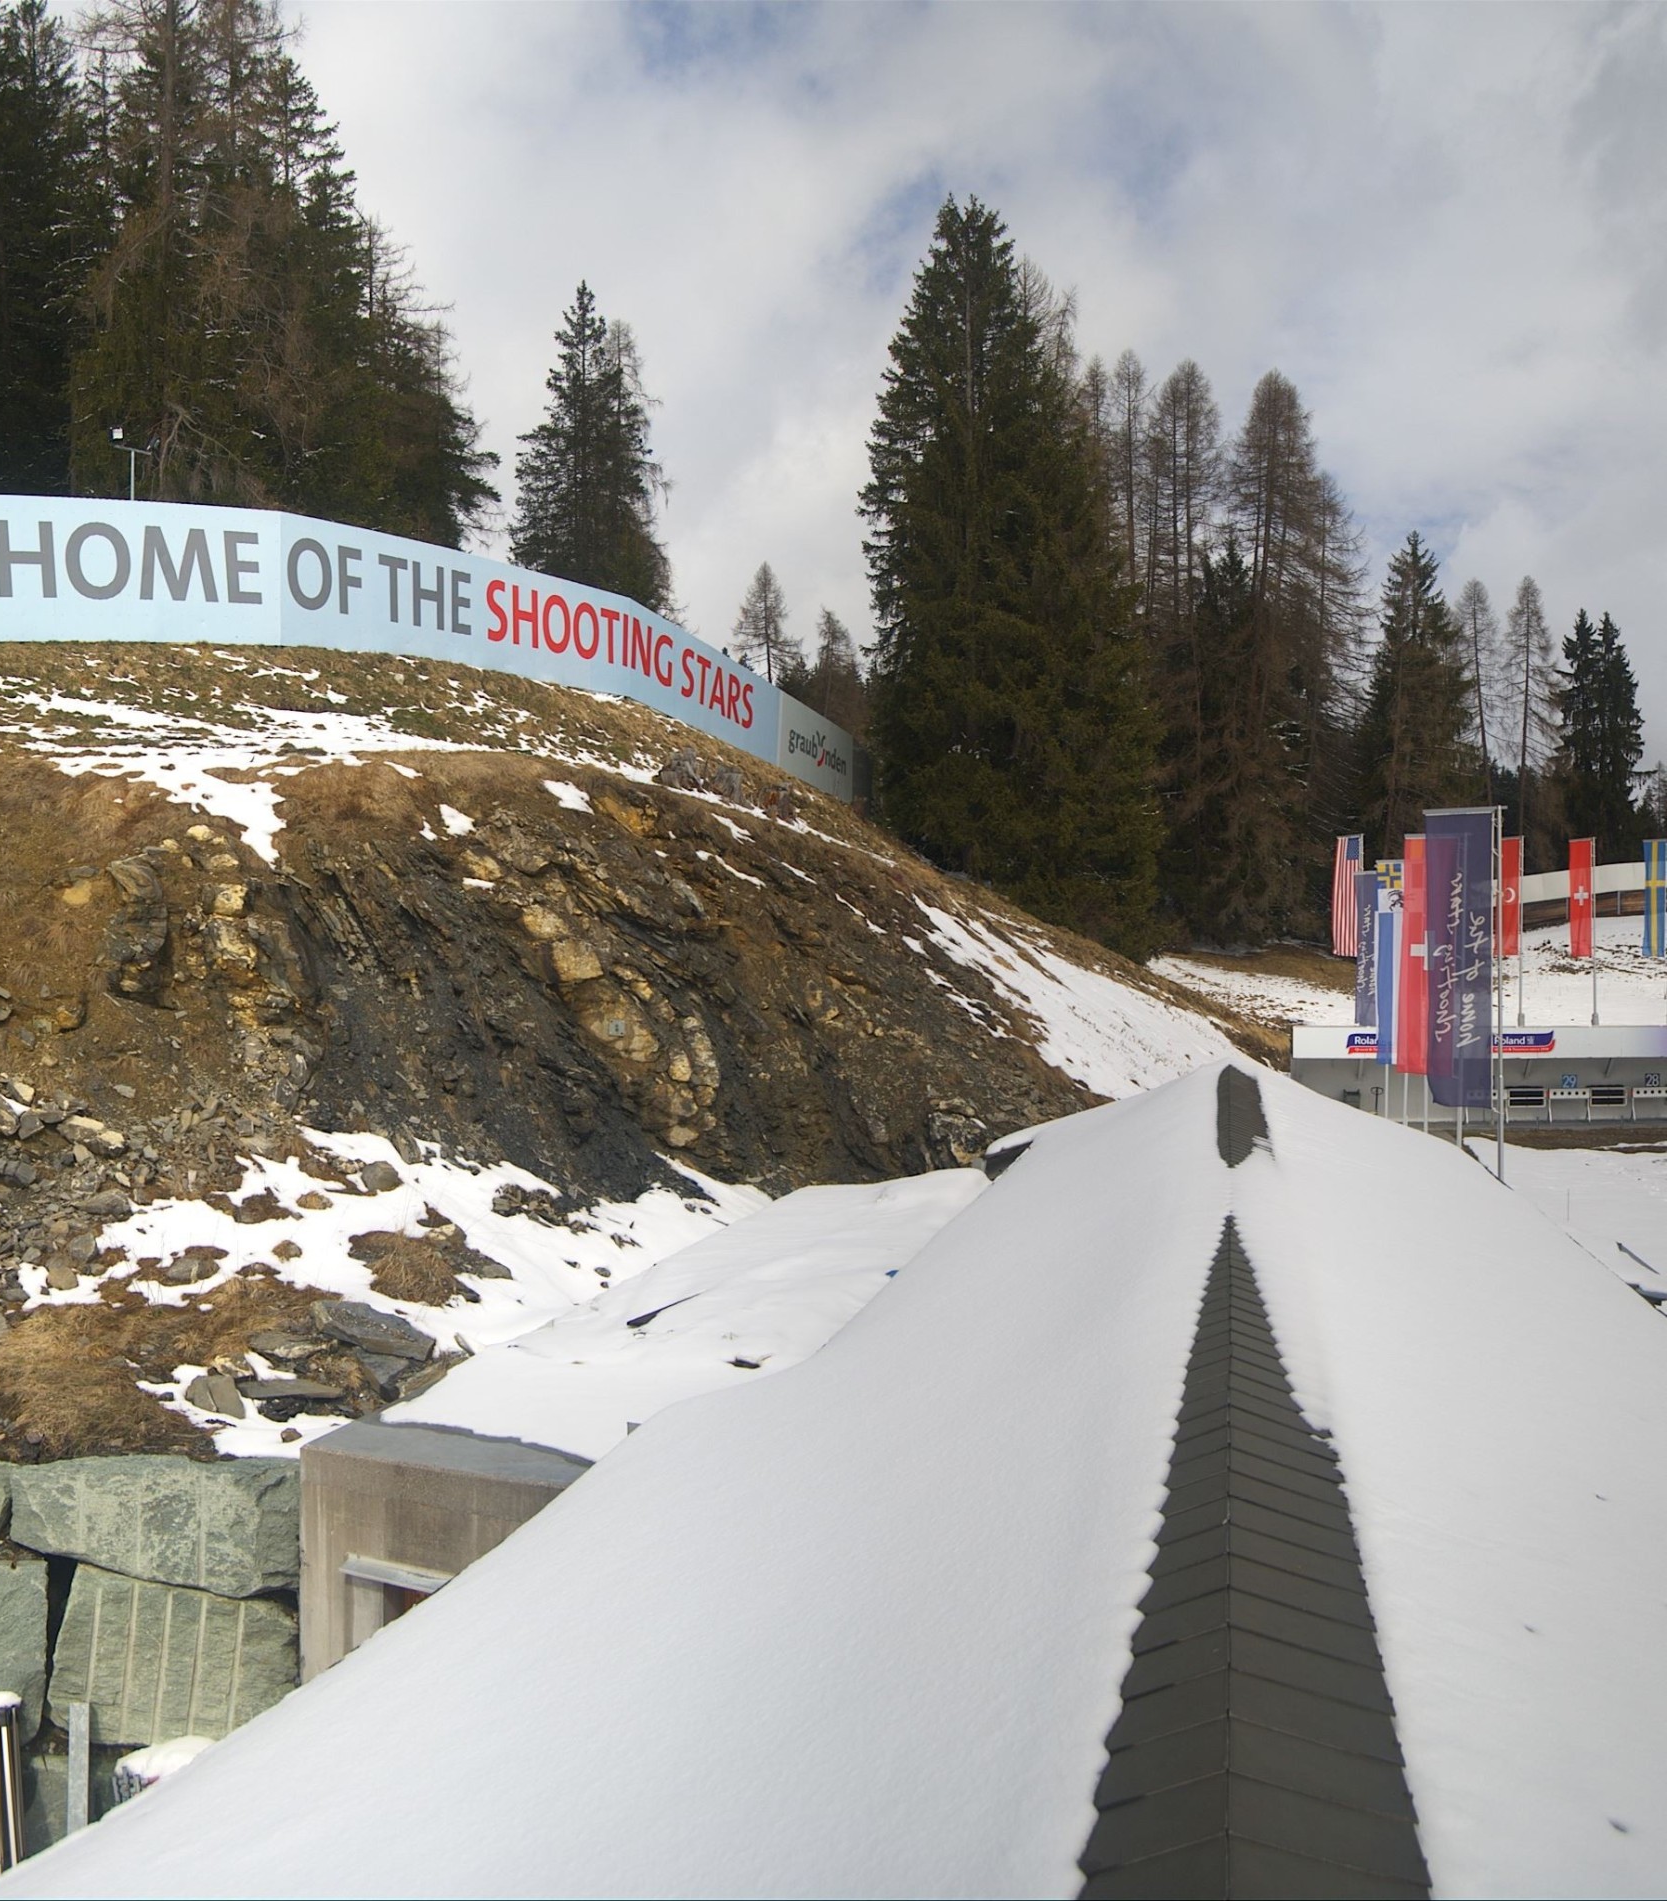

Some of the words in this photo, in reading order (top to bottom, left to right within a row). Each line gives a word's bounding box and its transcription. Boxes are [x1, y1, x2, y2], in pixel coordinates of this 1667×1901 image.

[286, 537, 362, 615] OF
[378, 553, 472, 636] THE
[486, 579, 674, 688] SHOOTING
[680, 648, 754, 729] STARS
[1562, 1075, 1577, 1088] 29
[1646, 1074, 1659, 1087] 28
